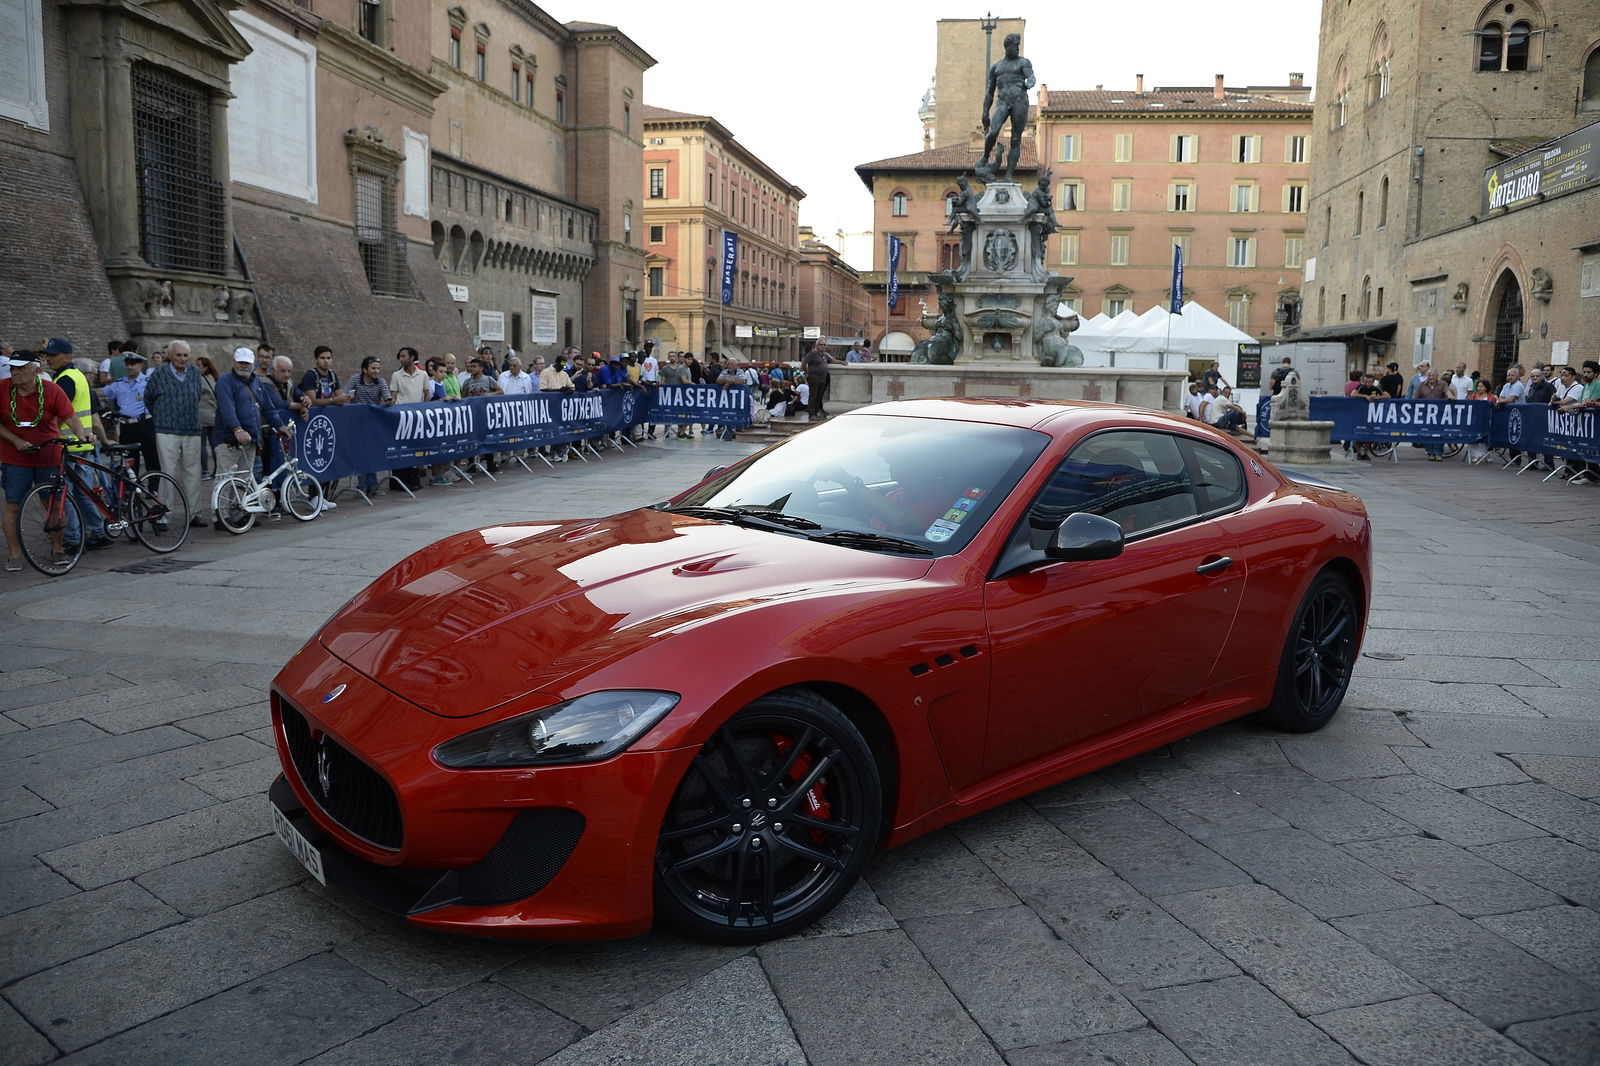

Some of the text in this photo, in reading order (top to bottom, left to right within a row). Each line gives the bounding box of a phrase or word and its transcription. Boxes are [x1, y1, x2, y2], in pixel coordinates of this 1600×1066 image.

[1489, 171, 1540, 209] ARTELIBRO
[725, 237, 735, 284] MASERATI
[659, 386, 745, 410] MASERATI
[1367, 402, 1473, 426] MASERATI
[306, 419, 334, 448] MASERATI
[395, 405, 473, 440] MASERATI
[486, 399, 553, 430] CENTENNIAL
[1548, 409, 1595, 439] MASERATI
[295, 834, 319, 874] MAS
